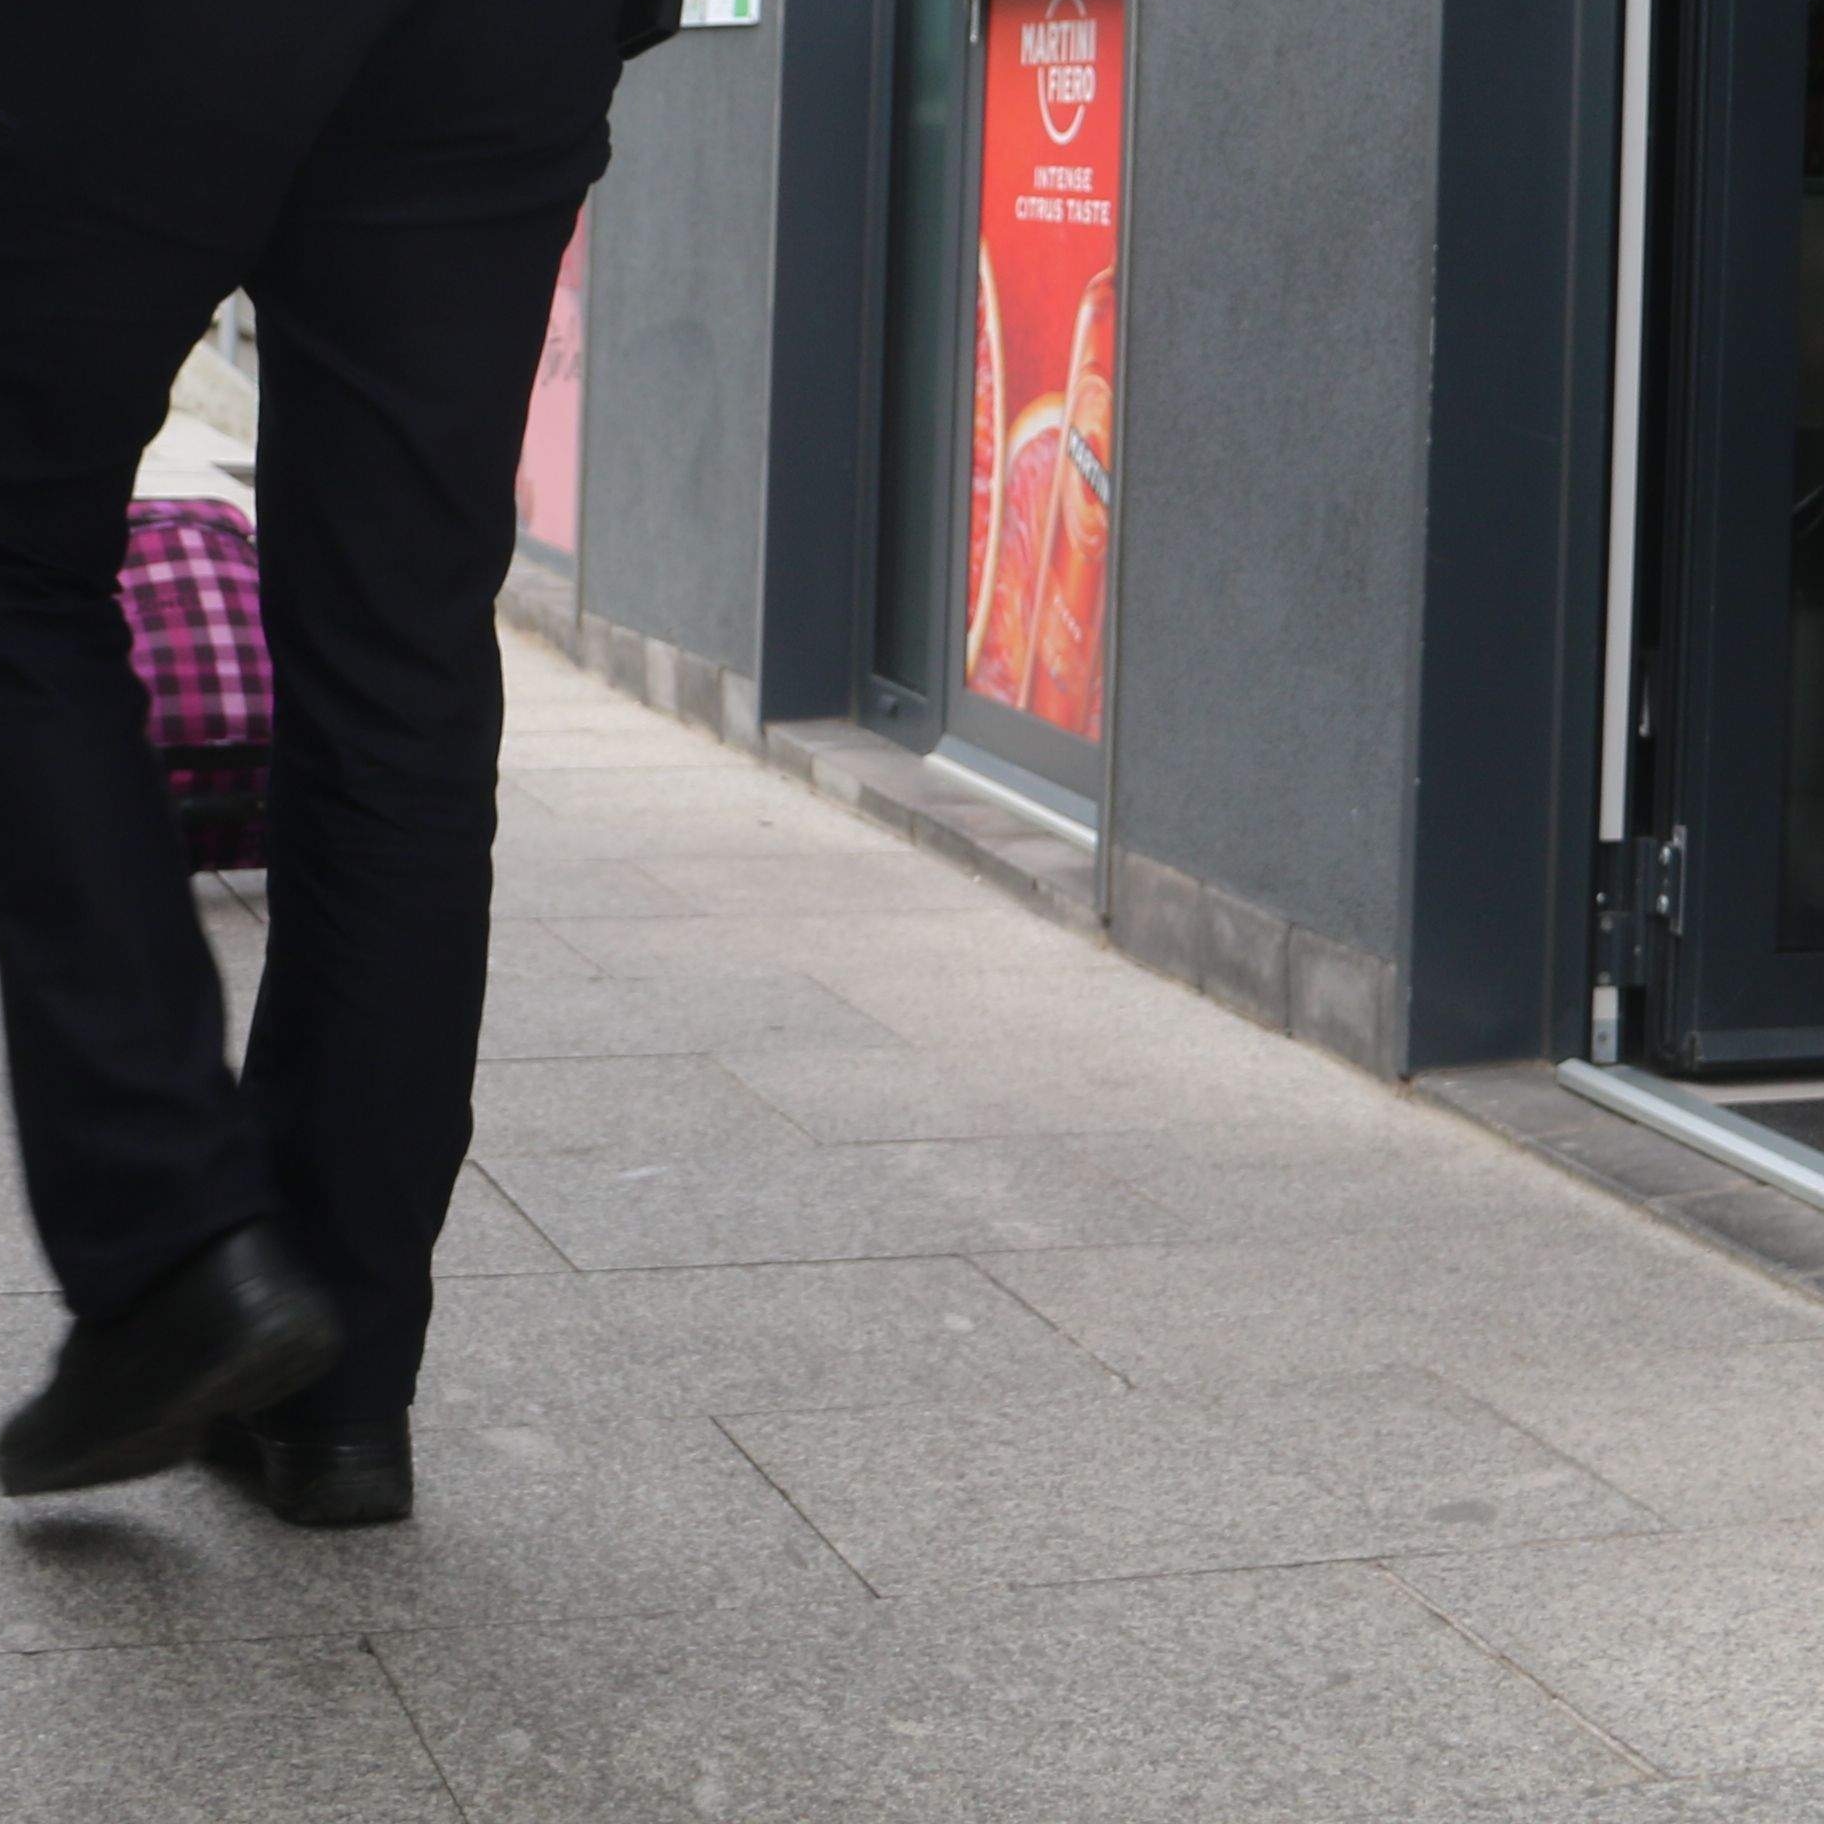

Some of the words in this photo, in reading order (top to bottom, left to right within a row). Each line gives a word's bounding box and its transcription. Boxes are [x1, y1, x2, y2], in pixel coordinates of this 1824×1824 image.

[1020, 19, 1097, 65] MARTINI
[1047, 65, 1096, 104] FIERO
[1033, 165, 1094, 193] INTENSE
[1015, 195, 1065, 223] CITRUS
[1066, 199, 1111, 226] TASTE
